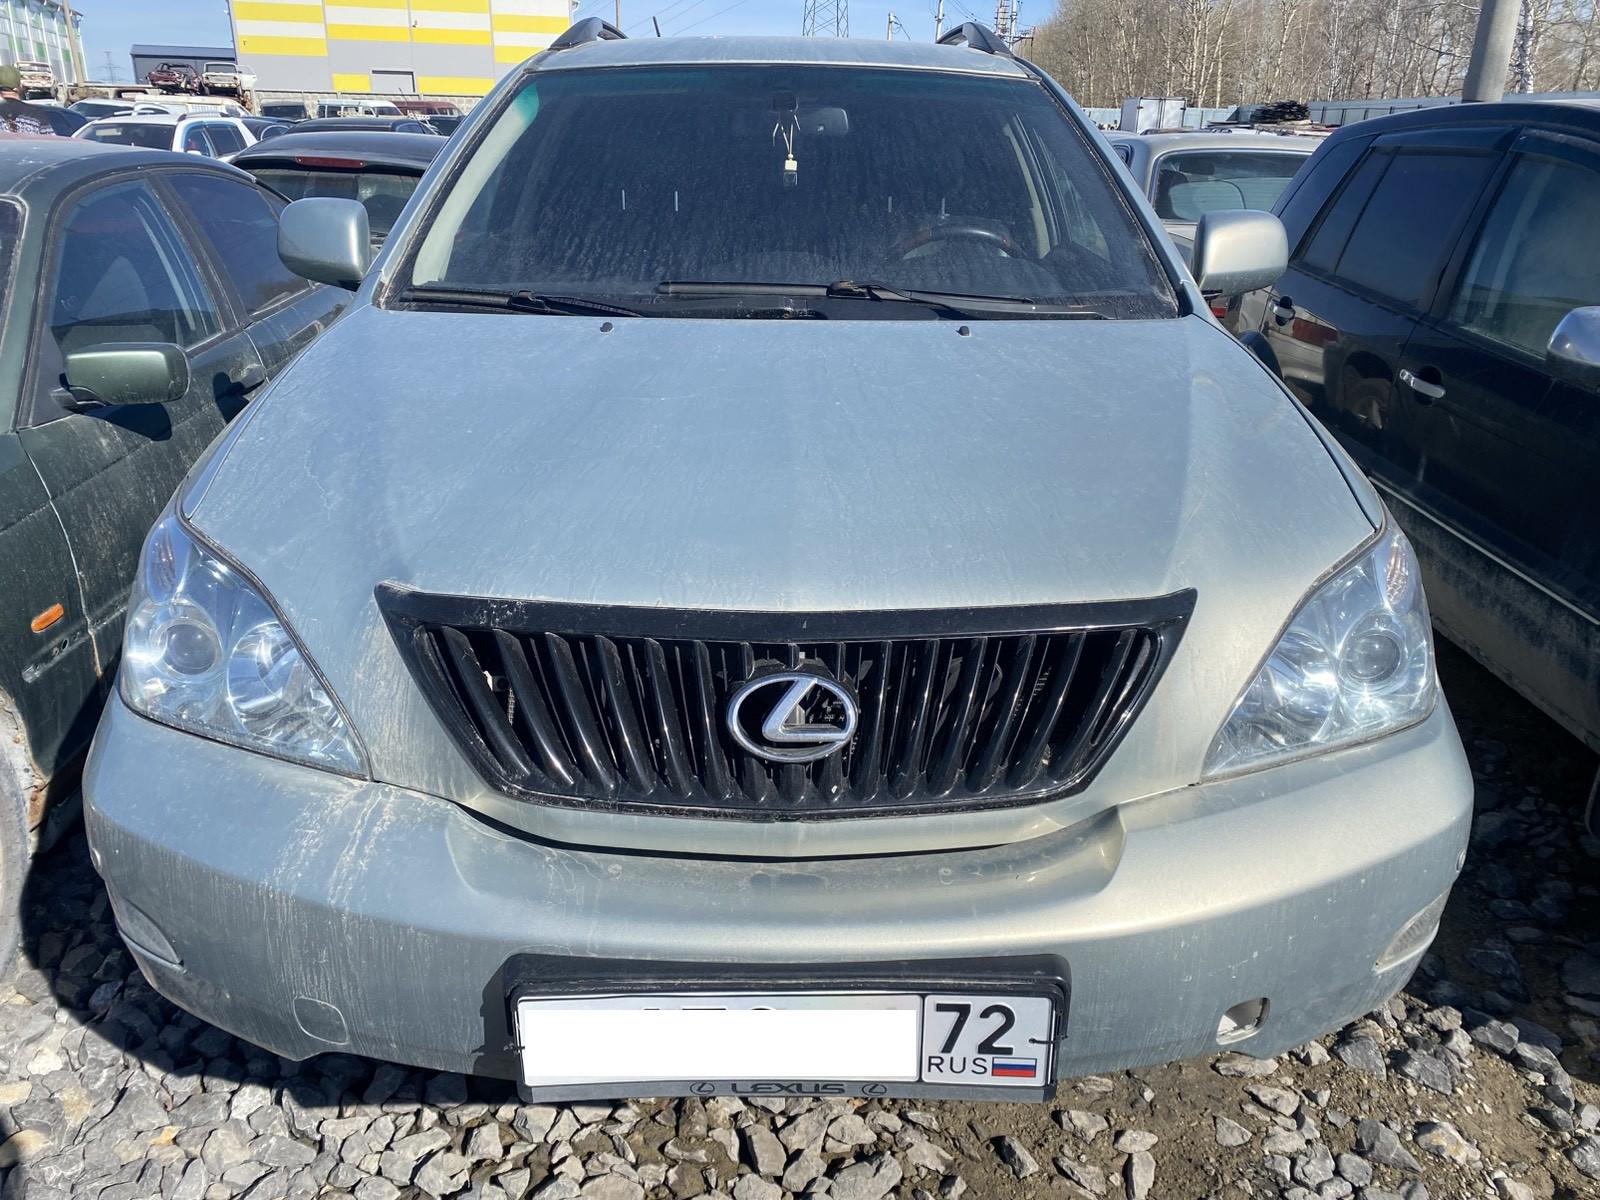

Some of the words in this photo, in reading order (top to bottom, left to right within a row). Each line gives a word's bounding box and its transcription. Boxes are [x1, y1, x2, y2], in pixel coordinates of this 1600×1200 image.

[935, 1003, 1016, 1055] 72
[927, 1055, 988, 1075] RUS
[731, 1083, 846, 1094] LEXUS
